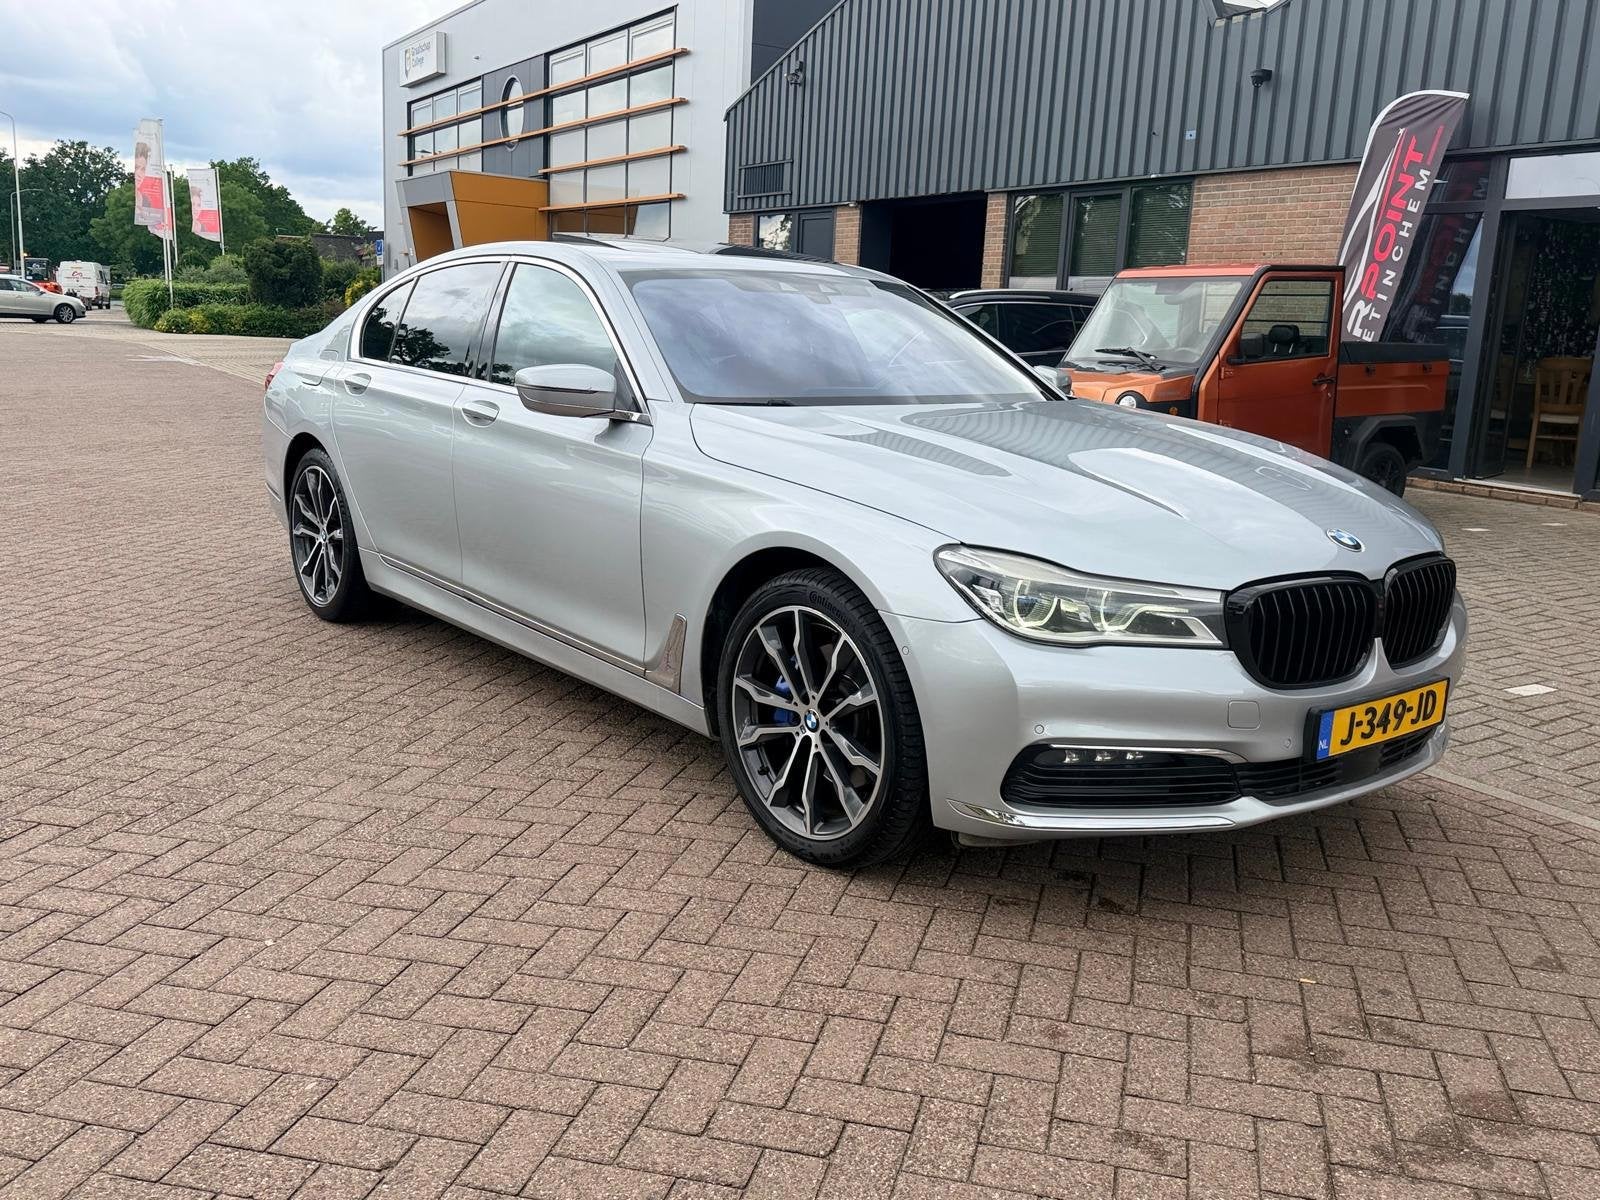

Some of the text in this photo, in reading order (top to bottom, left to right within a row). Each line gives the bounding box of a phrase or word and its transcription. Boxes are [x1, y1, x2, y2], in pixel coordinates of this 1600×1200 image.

[1347, 135, 1424, 340] RPOINT
[1362, 168, 1431, 342] ETINCHEM
[1318, 739, 1329, 751] NL
[1340, 689, 1437, 746] J-349-JD
